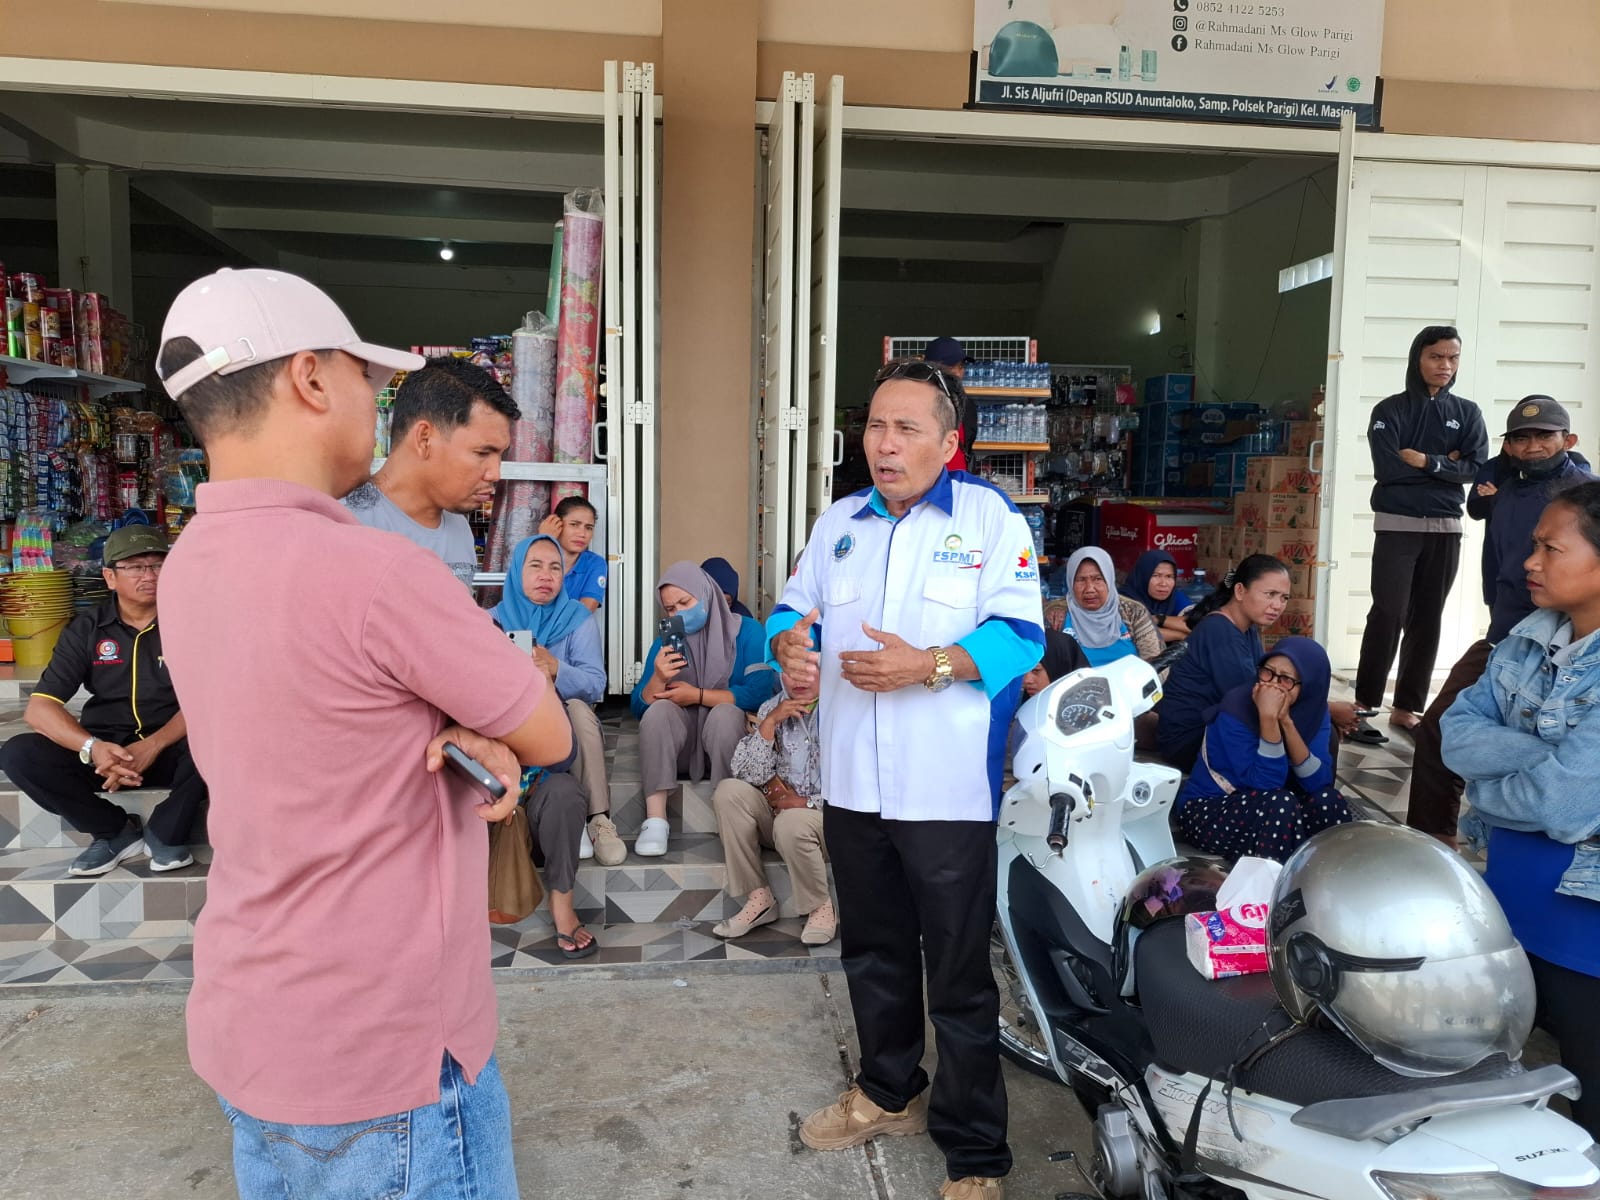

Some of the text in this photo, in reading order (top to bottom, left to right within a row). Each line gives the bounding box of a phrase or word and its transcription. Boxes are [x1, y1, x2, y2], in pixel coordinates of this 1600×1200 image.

[1196, 2, 1285, 17] 0852 4122 5253
[1195, 20, 1353, 43] @Rahmadani Ms Glow Parigi
[1194, 39, 1340, 61] Rahmadani Ms Glow Parigi
[1001, 85, 1013, 99] Jl.
[1015, 86, 1030, 100] Sis
[1031, 87, 1064, 104] Aljufri
[1066, 88, 1103, 106] (Depan
[1105, 91, 1133, 105] RSUD
[1135, 93, 1197, 111] Anuntaloko,
[1199, 97, 1231, 113] Samp.
[1232, 98, 1265, 113] Polsek
[1266, 102, 1299, 118] Parigi)
[1300, 104, 1319, 117] Kel.
[1153, 532, 1193, 551] Glico
[933, 551, 975, 564] FSPMI
